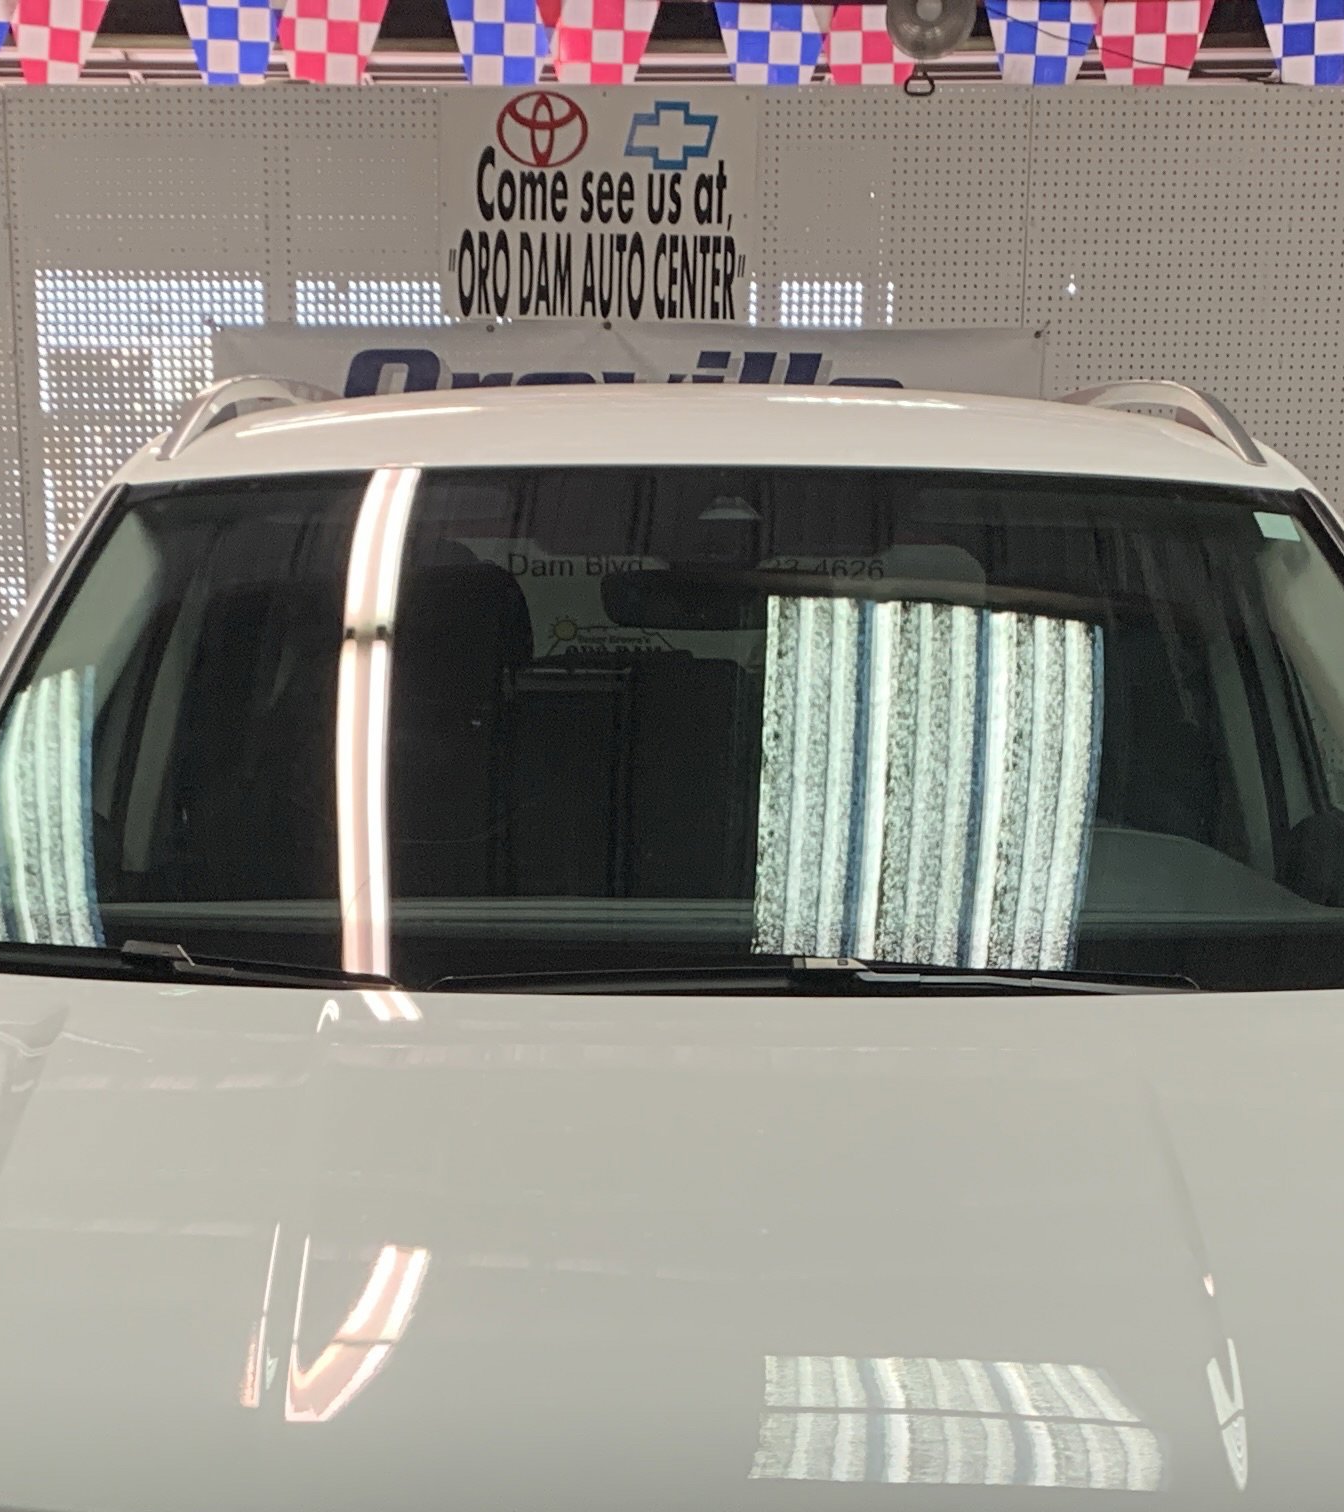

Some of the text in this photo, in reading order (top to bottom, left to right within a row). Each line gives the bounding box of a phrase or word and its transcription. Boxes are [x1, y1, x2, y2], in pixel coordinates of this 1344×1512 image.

[476, 145, 569, 223] Come
[580, 170, 635, 224] see
[647, 172, 683, 226] us
[518, 231, 573, 316] DAM
[579, 230, 646, 321] AUTO
[508, 553, 574, 577] Dam
